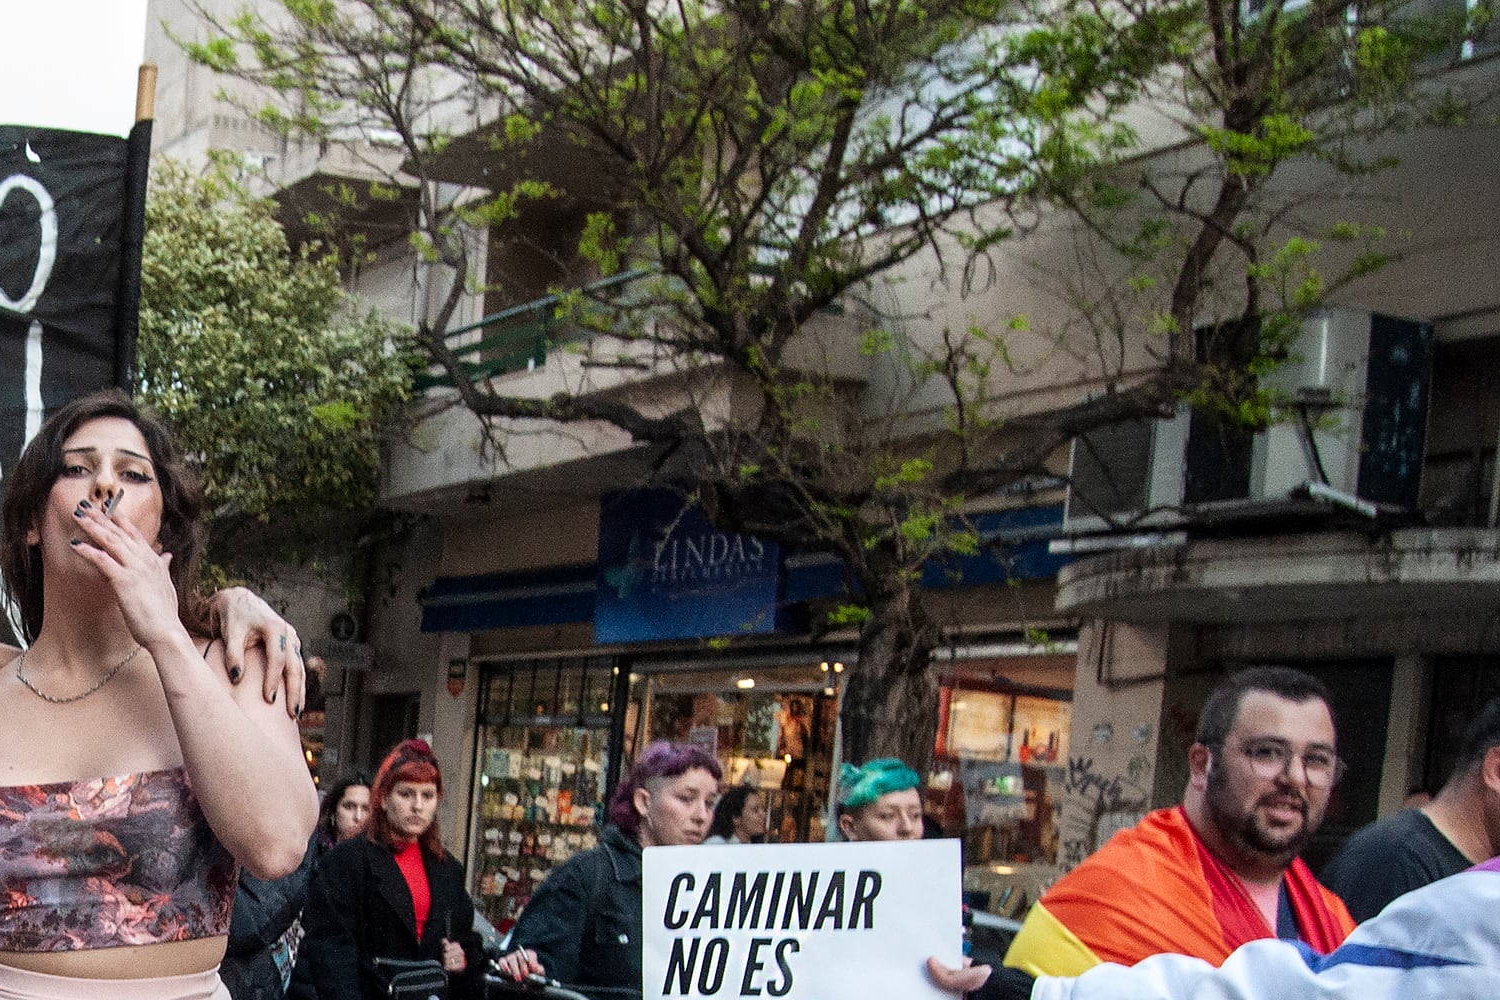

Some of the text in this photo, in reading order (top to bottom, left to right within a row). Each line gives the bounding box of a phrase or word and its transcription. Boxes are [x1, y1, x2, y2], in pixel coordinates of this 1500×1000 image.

[663, 870, 882, 930] CAMINAR
[662, 937, 800, 996] NO ES
